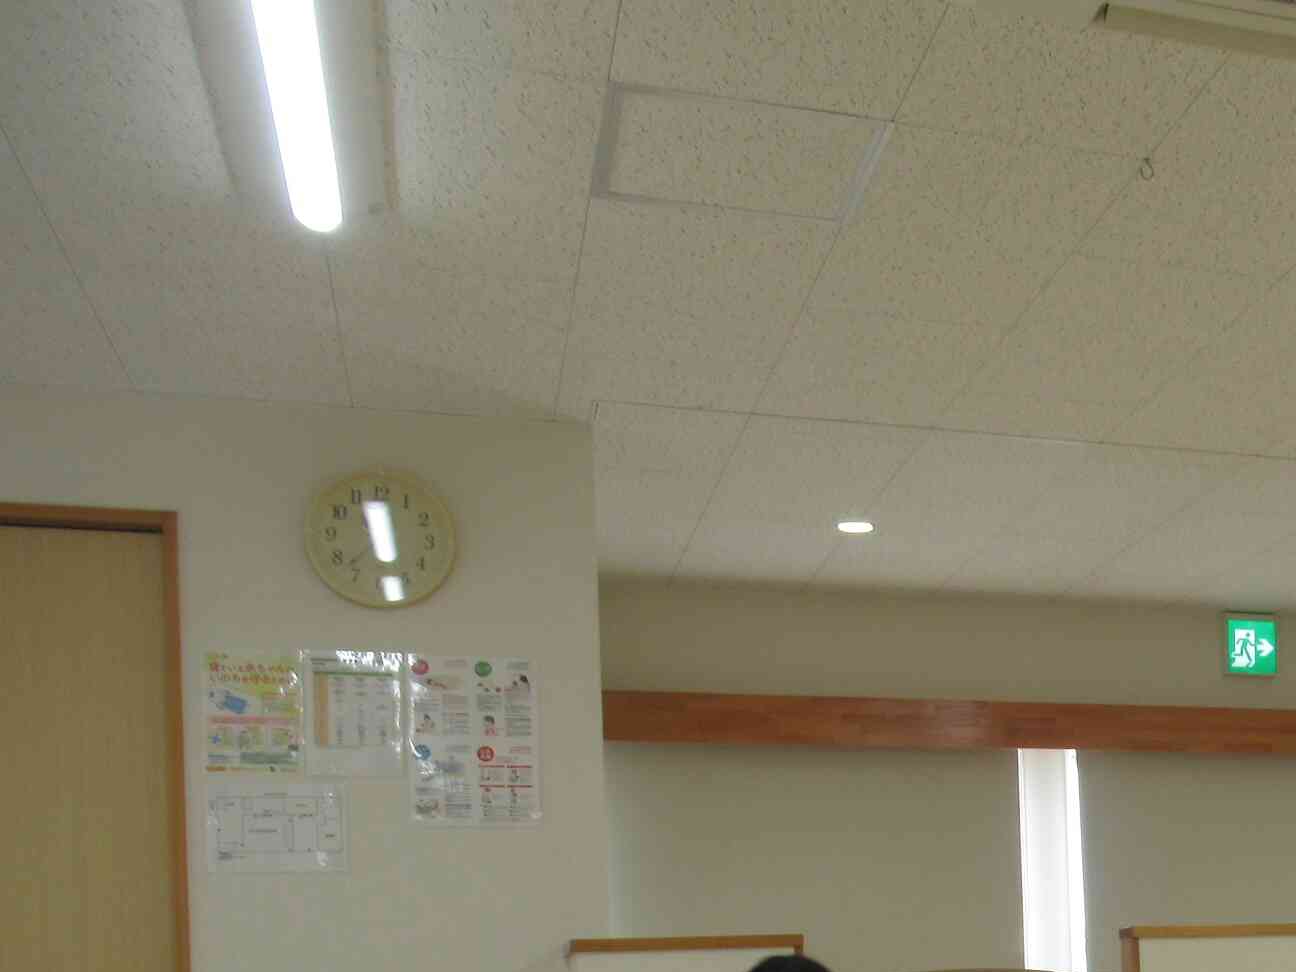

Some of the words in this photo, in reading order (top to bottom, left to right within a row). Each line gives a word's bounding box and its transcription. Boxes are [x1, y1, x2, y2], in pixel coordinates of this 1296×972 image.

[403, 494, 409, 510] 1
[332, 504, 348, 520] 10
[417, 511, 430, 527] 2
[325, 527, 337, 542] 9
[424, 535, 435, 550] 3
[331, 551, 344, 566] 8
[416, 557, 425, 570] 4
[351, 567, 361, 583] 7
